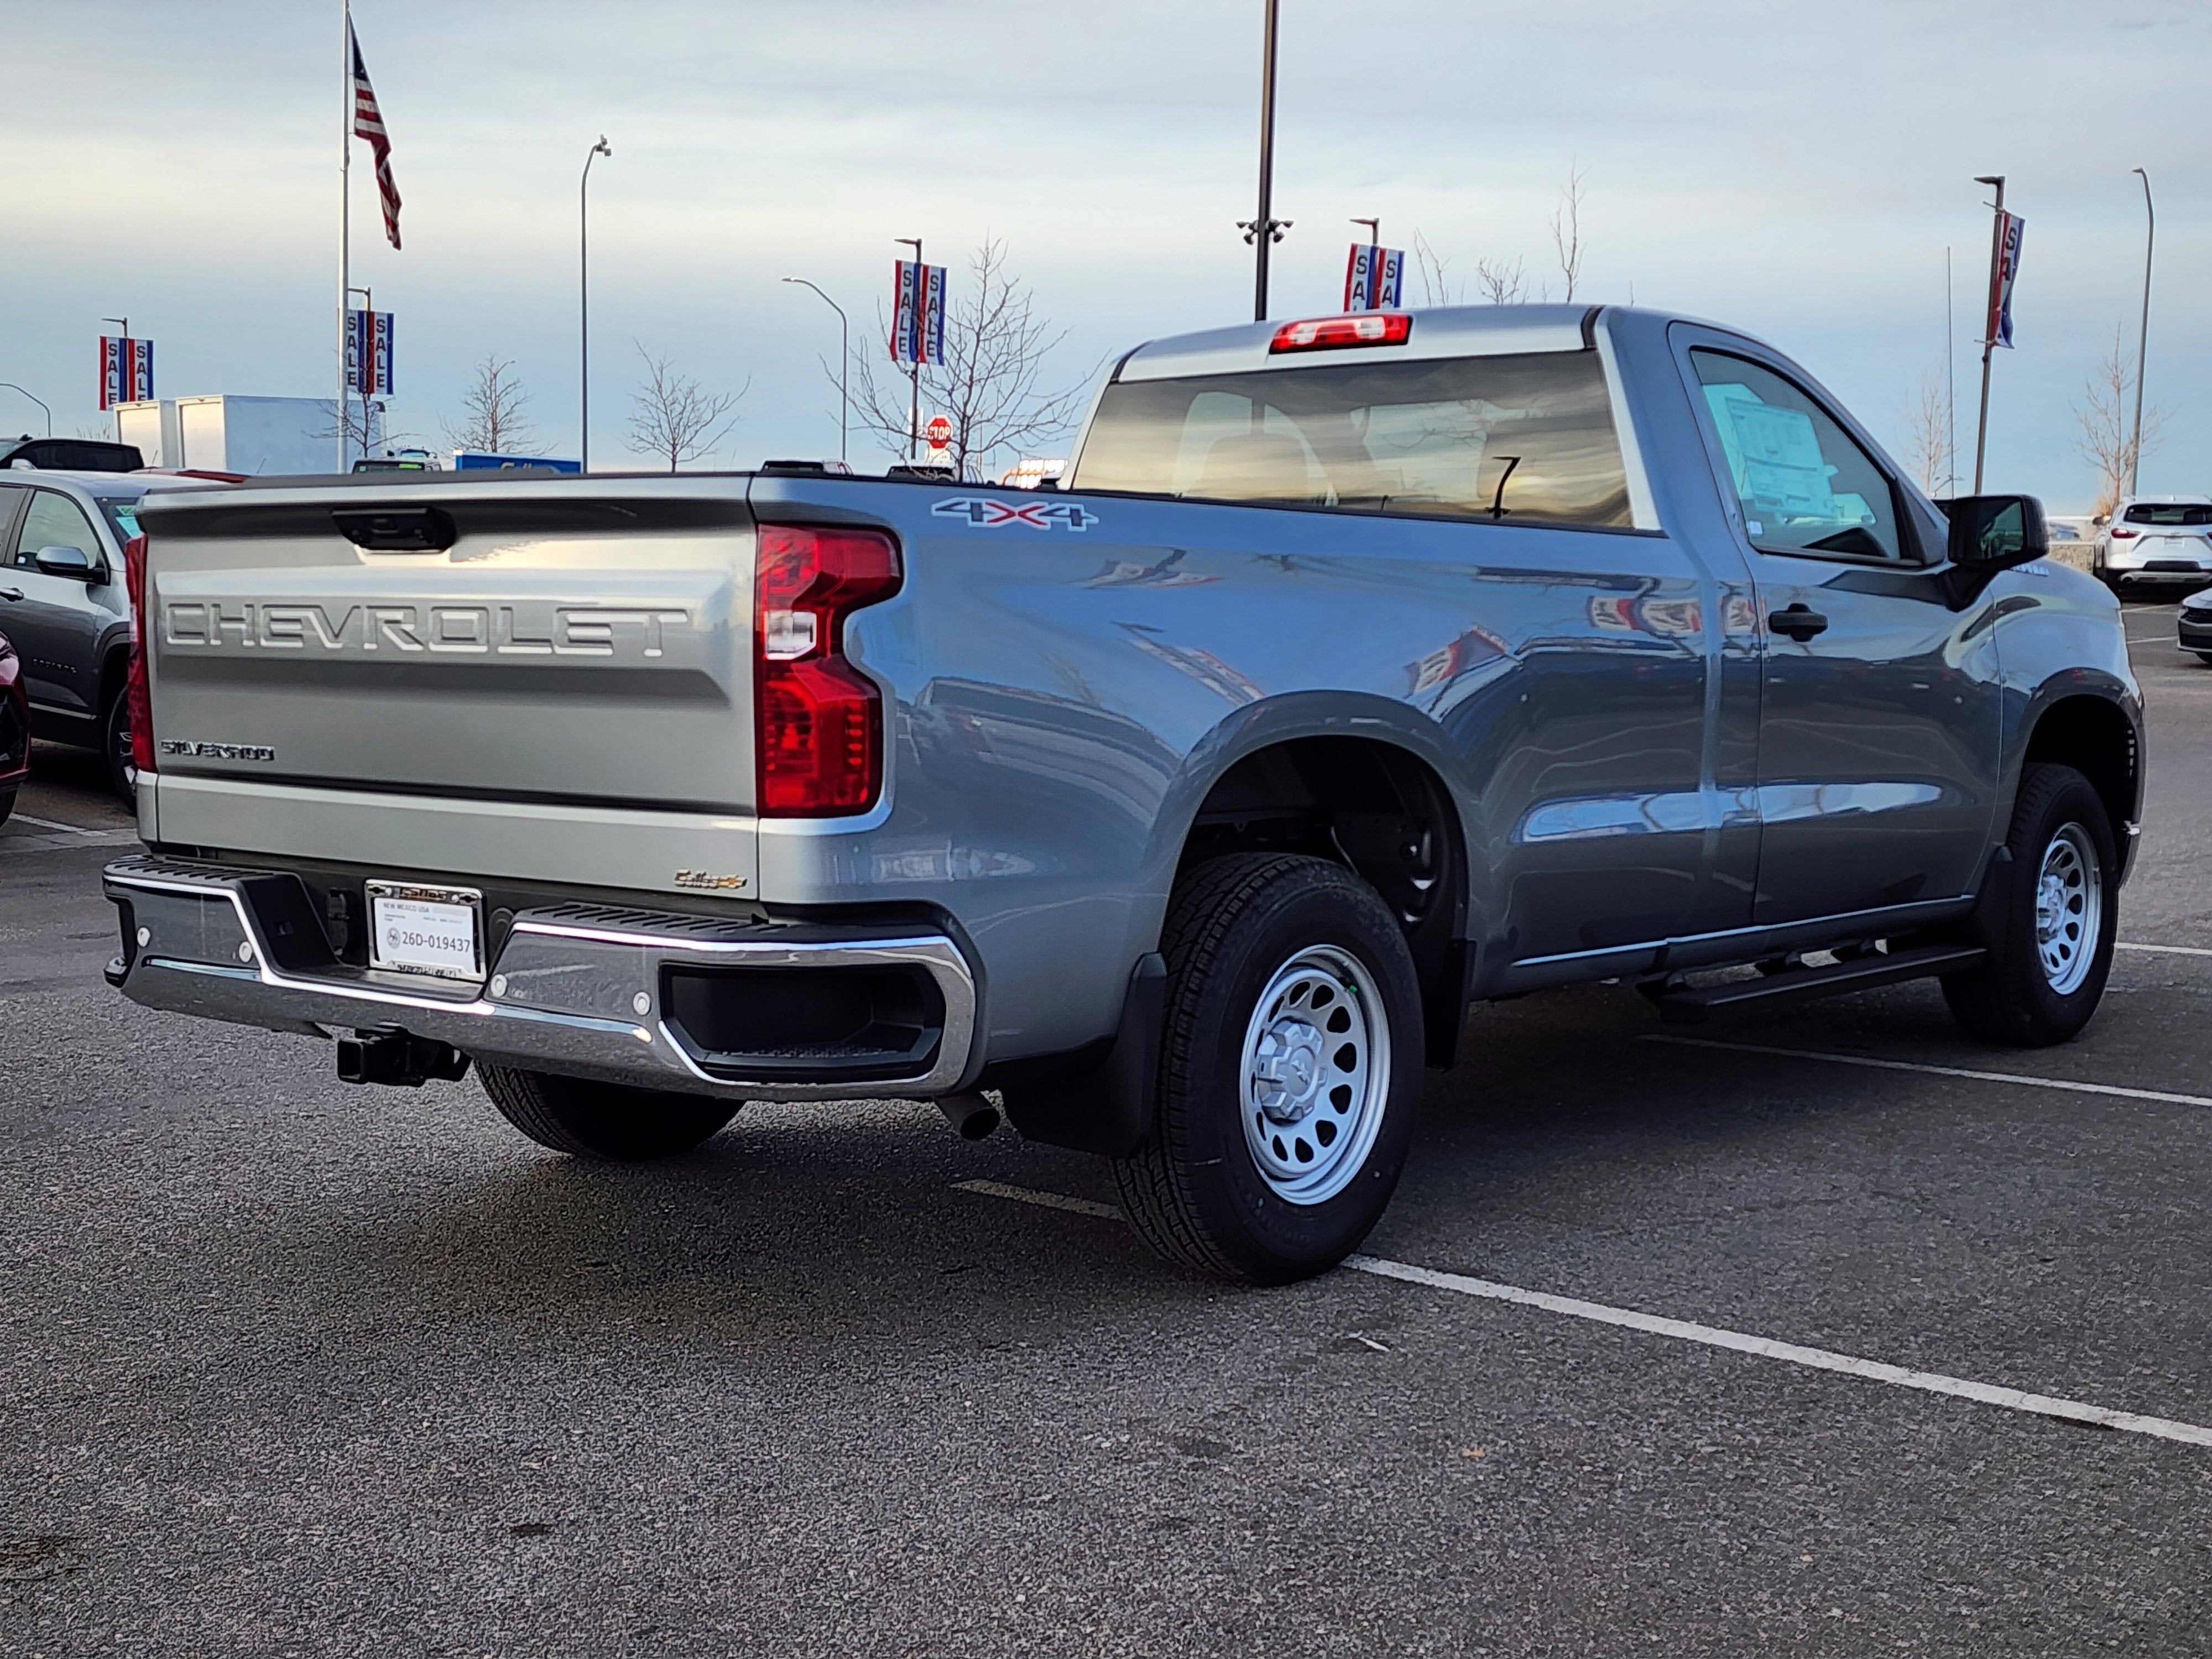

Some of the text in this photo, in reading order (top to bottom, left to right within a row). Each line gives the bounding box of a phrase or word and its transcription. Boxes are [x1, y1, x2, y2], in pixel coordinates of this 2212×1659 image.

[1382, 259, 1396, 304] SA
[2002, 227, 2017, 281] SA
[1353, 255, 1368, 311] SA
[899, 270, 912, 353] SALE
[926, 274, 939, 357] SALE
[107, 343, 118, 405] SALE
[347, 316, 357, 385] SALE
[376, 319, 386, 388] SALE
[927, 426, 951, 440] STOP
[167, 603, 687, 658] CHEVROLET
[161, 739, 275, 761] SILVERADO
[402, 931, 470, 952] 26D-019437
